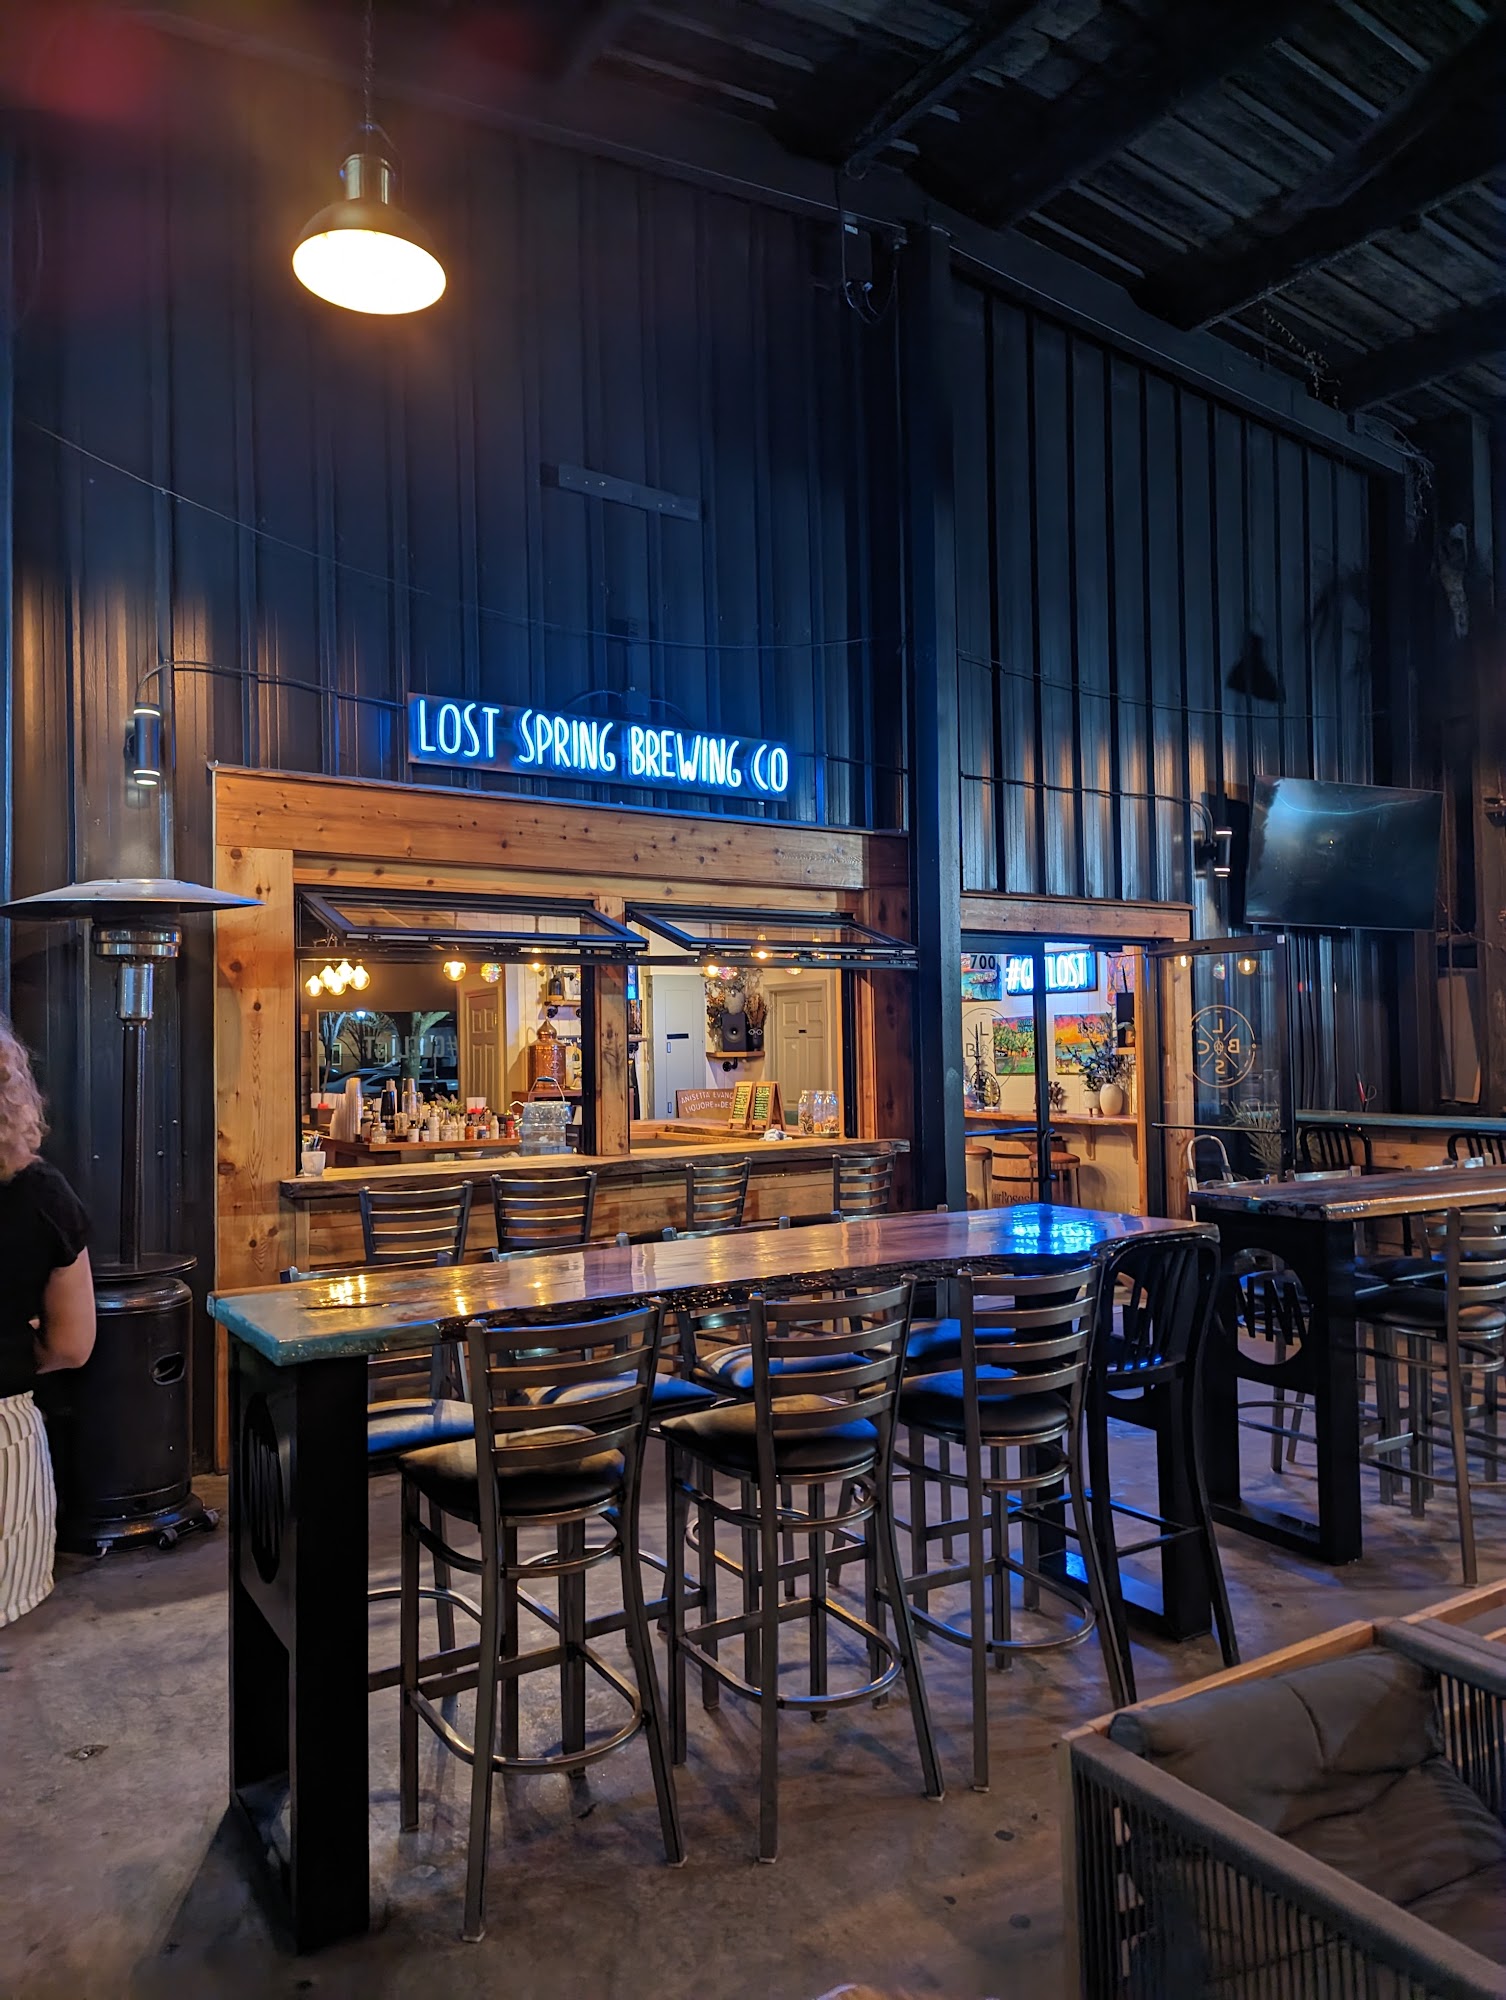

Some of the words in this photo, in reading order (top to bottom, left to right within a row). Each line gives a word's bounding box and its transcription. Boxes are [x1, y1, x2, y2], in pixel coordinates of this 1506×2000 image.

[419, 699, 499, 757] LOST
[517, 708, 616, 773] SPRING
[628, 724, 743, 789] BREWING
[751, 742, 790, 793] CO
[970, 954, 996, 970] 700
[681, 1091, 711, 1105] ANISETTA
[685, 1101, 713, 1113] LIQUORE
